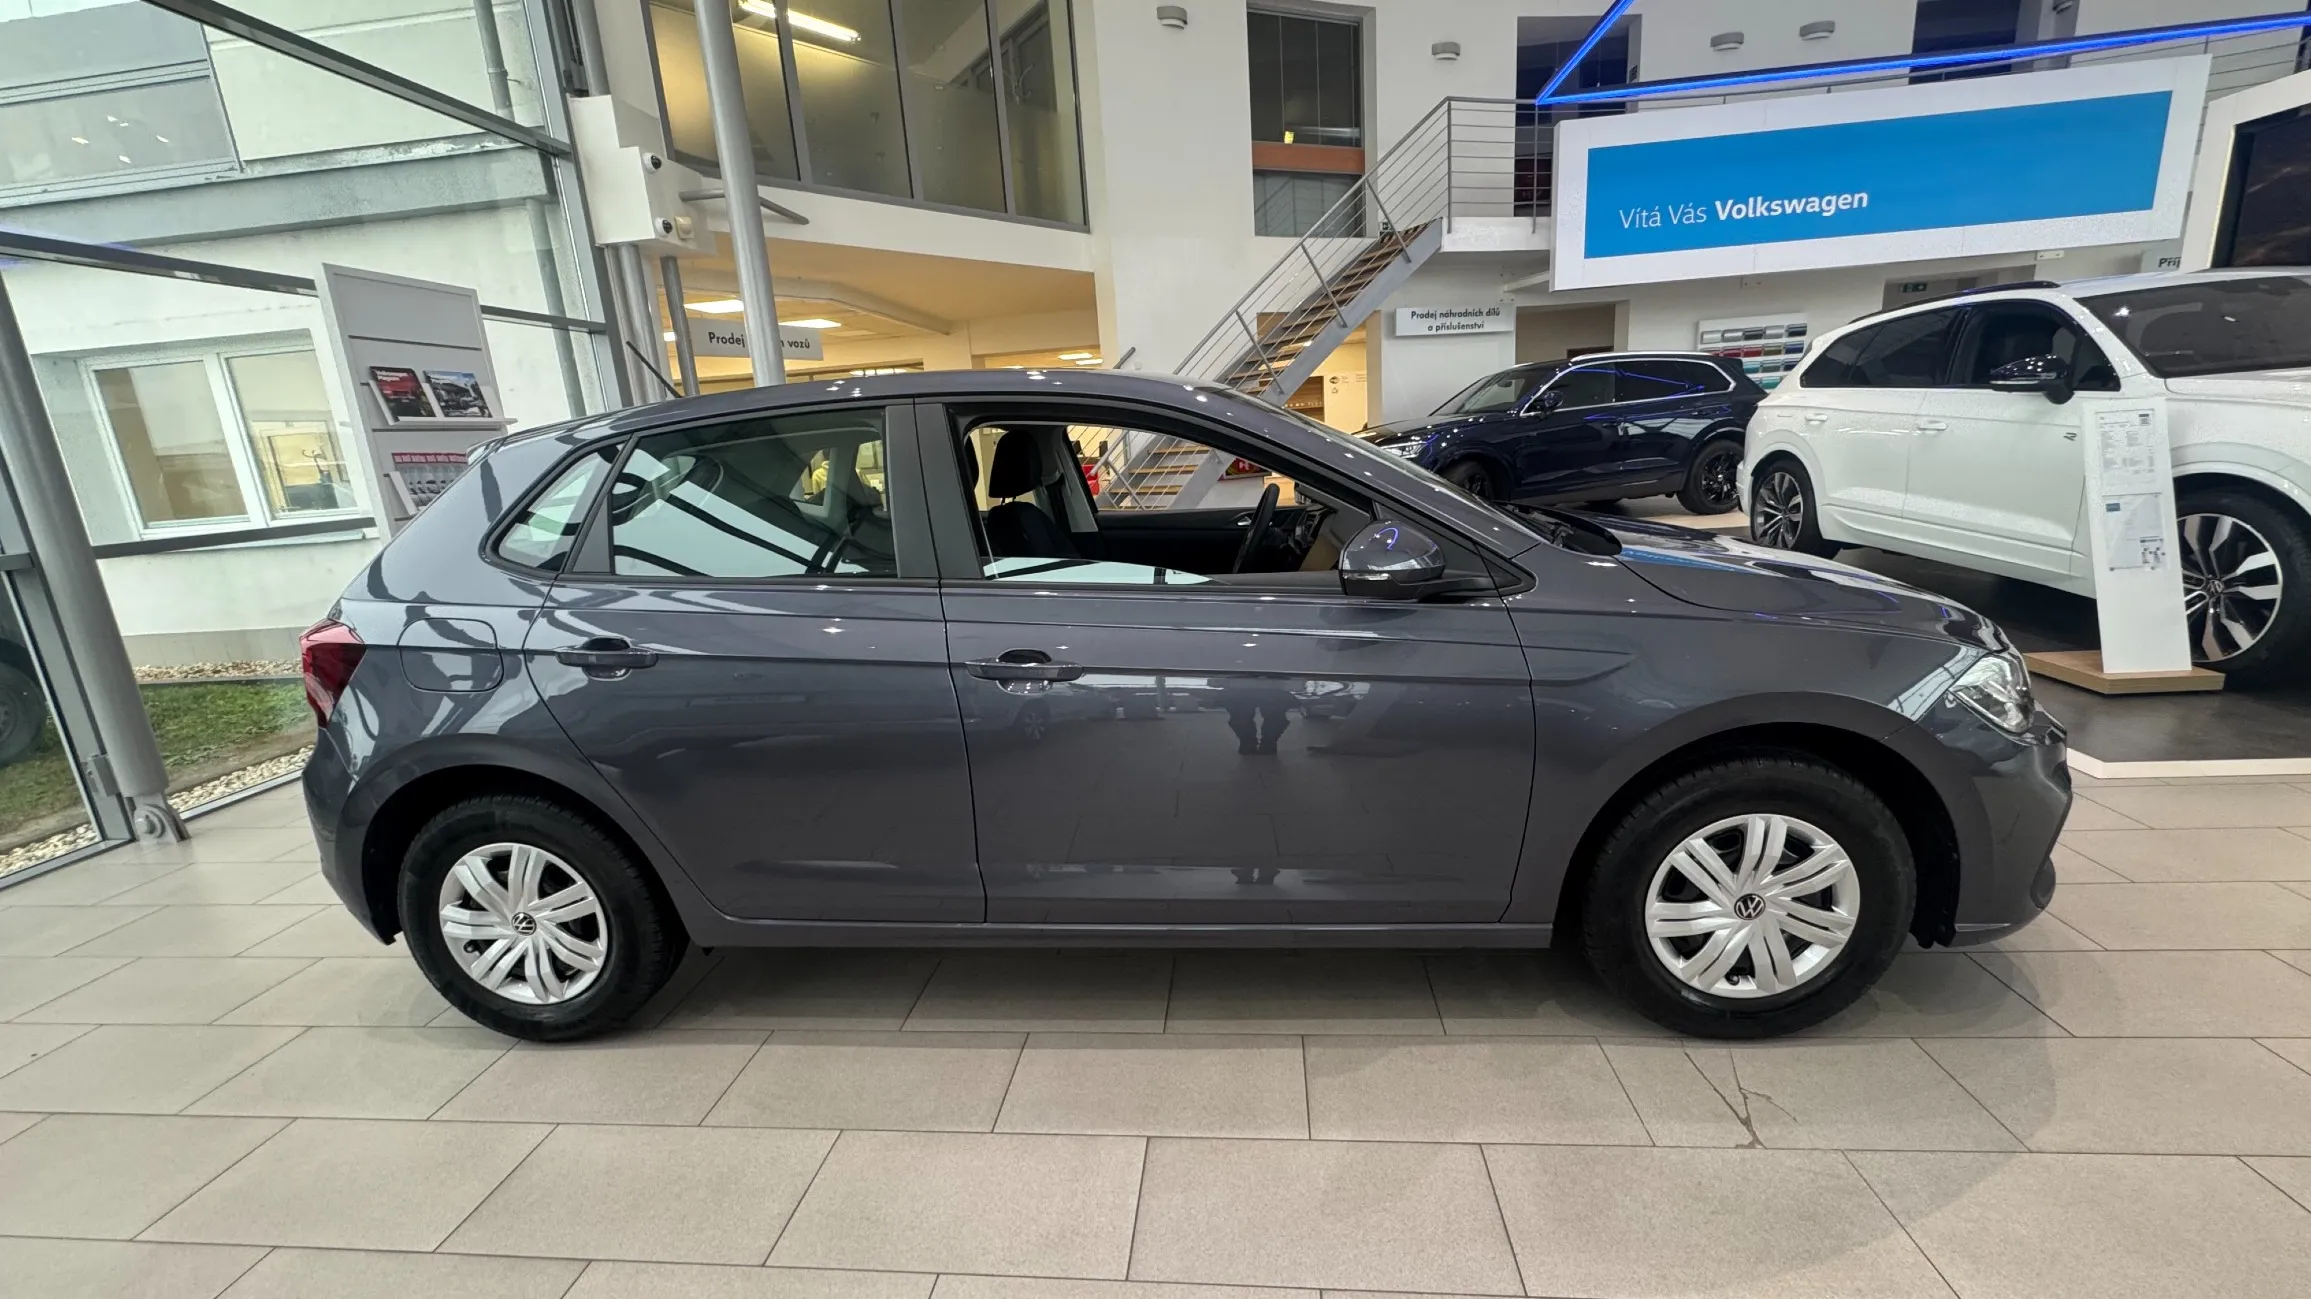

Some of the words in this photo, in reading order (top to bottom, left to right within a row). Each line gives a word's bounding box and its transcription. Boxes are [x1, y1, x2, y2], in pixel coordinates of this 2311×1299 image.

[1619, 206, 1662, 229] Vítá
[1668, 203, 1708, 225] Vás
[1714, 191, 1869, 221] Volkswagen
[2158, 256, 2182, 269] Příj
[1411, 309, 1438, 321] Prodej
[1439, 307, 1484, 318] náhradních
[1485, 306, 1501, 317] dílů
[1435, 320, 1485, 333] příslušenství
[708, 331, 746, 349] Prodej
[787, 338, 811, 349] vozů
